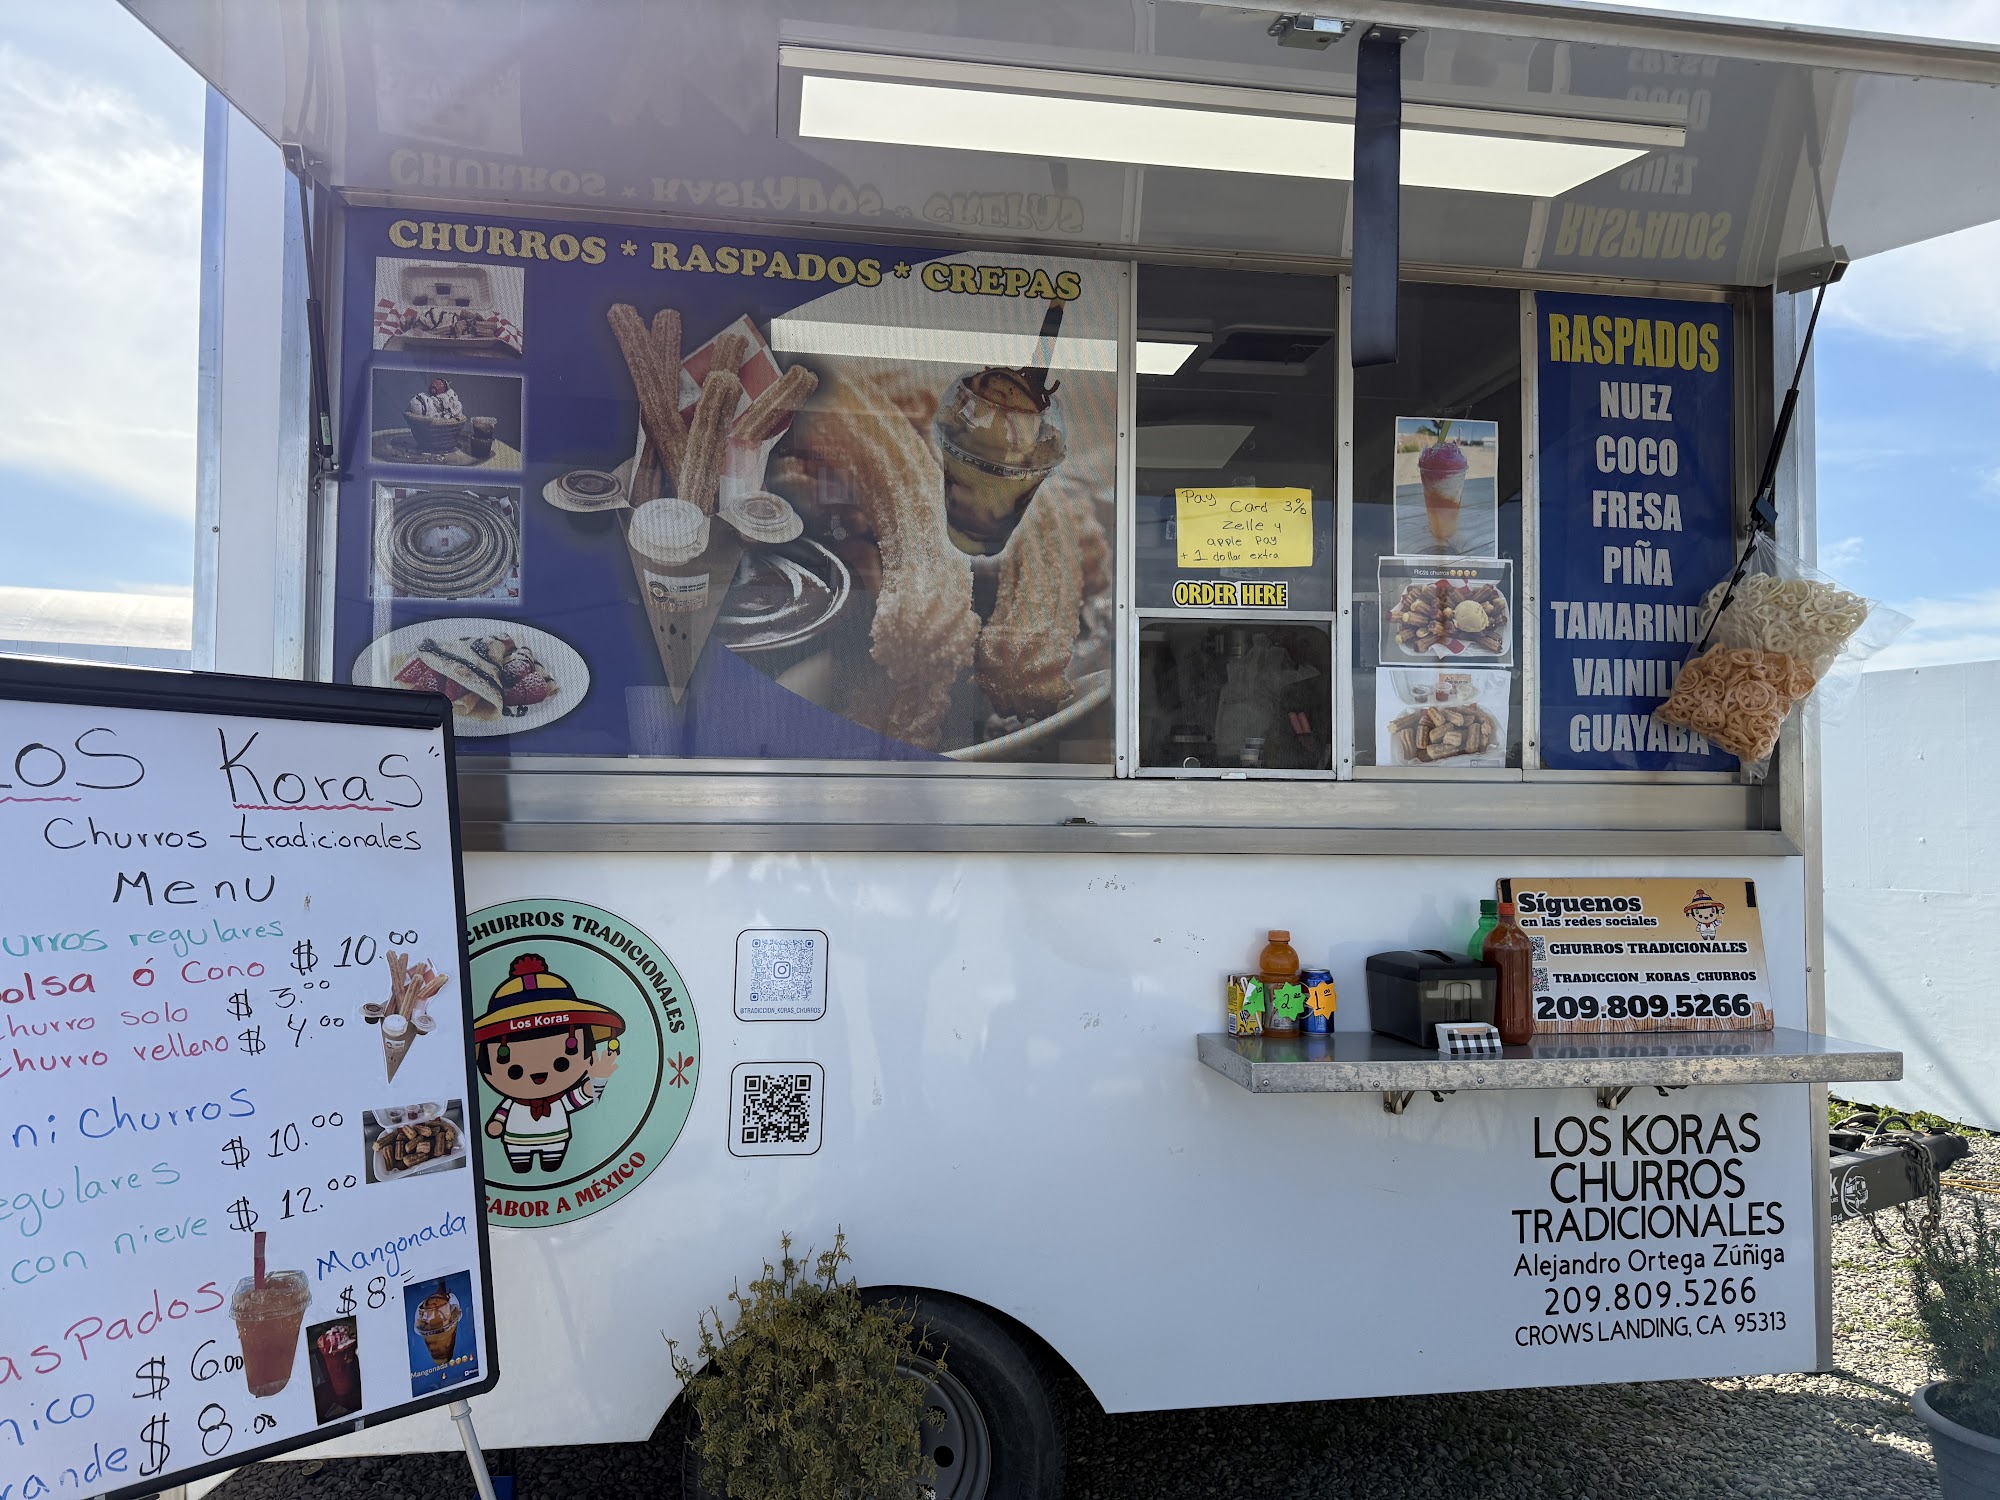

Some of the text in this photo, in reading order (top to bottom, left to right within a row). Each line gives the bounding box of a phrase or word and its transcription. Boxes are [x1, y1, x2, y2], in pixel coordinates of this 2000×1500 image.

[388, 219, 1081, 300] CHURROS RASPADOS CREPAS
[1548, 313, 1720, 373] RASPADOS
[1599, 381, 1673, 422] NUEZ
[1595, 435, 1679, 478] COCO
[1181, 490, 1217, 506] Pay
[1230, 498, 1307, 515] Card 3%
[1592, 490, 1683, 532] FRESA
[1207, 536, 1242, 547] apple
[1213, 552, 1241, 562] dollar
[1249, 549, 1280, 560] extra
[1603, 540, 1674, 587] PIÑA
[1174, 582, 1287, 607] ORDER HERE
[1550, 601, 1700, 643] TAMARIND
[44, 814, 422, 851] Churros tradicionales
[112, 871, 275, 906] Menu
[1518, 893, 1642, 917] Síguenos
[129, 919, 284, 956] regulares
[1521, 916, 1658, 927] en las redes sociales
[1549, 942, 1748, 955] CHURROS TRADICIONALES
[0, 972, 96, 1004] olsa
[572, 913, 685, 1034] TRADICIONALES
[0, 1014, 96, 1040] hurro
[120, 1001, 188, 1026] solo
[509, 1012, 570, 1030] Los Koras
[1536, 993, 1751, 1020] 209.809.5266
[133, 1031, 230, 1062] relleno
[1534, 1112, 1761, 1159] LOS KORAS
[556, 1197, 572, 1214] A
[575, 1151, 646, 1207] MÉXICO
[1550, 1158, 1745, 1204] CHURROS
[1511, 1201, 1785, 1244] TRADICIONALES
[11, 1216, 208, 1284] con nieve
[316, 1211, 468, 1281] Mangonada
[1513, 1243, 1785, 1282] Alejandro Ortega Zúñiga
[1544, 1276, 1757, 1316] 209.809.5266
[1515, 1311, 1787, 1347] CROWS LANDING, CA 95313
[410, 1362, 448, 1379] Mangonada
